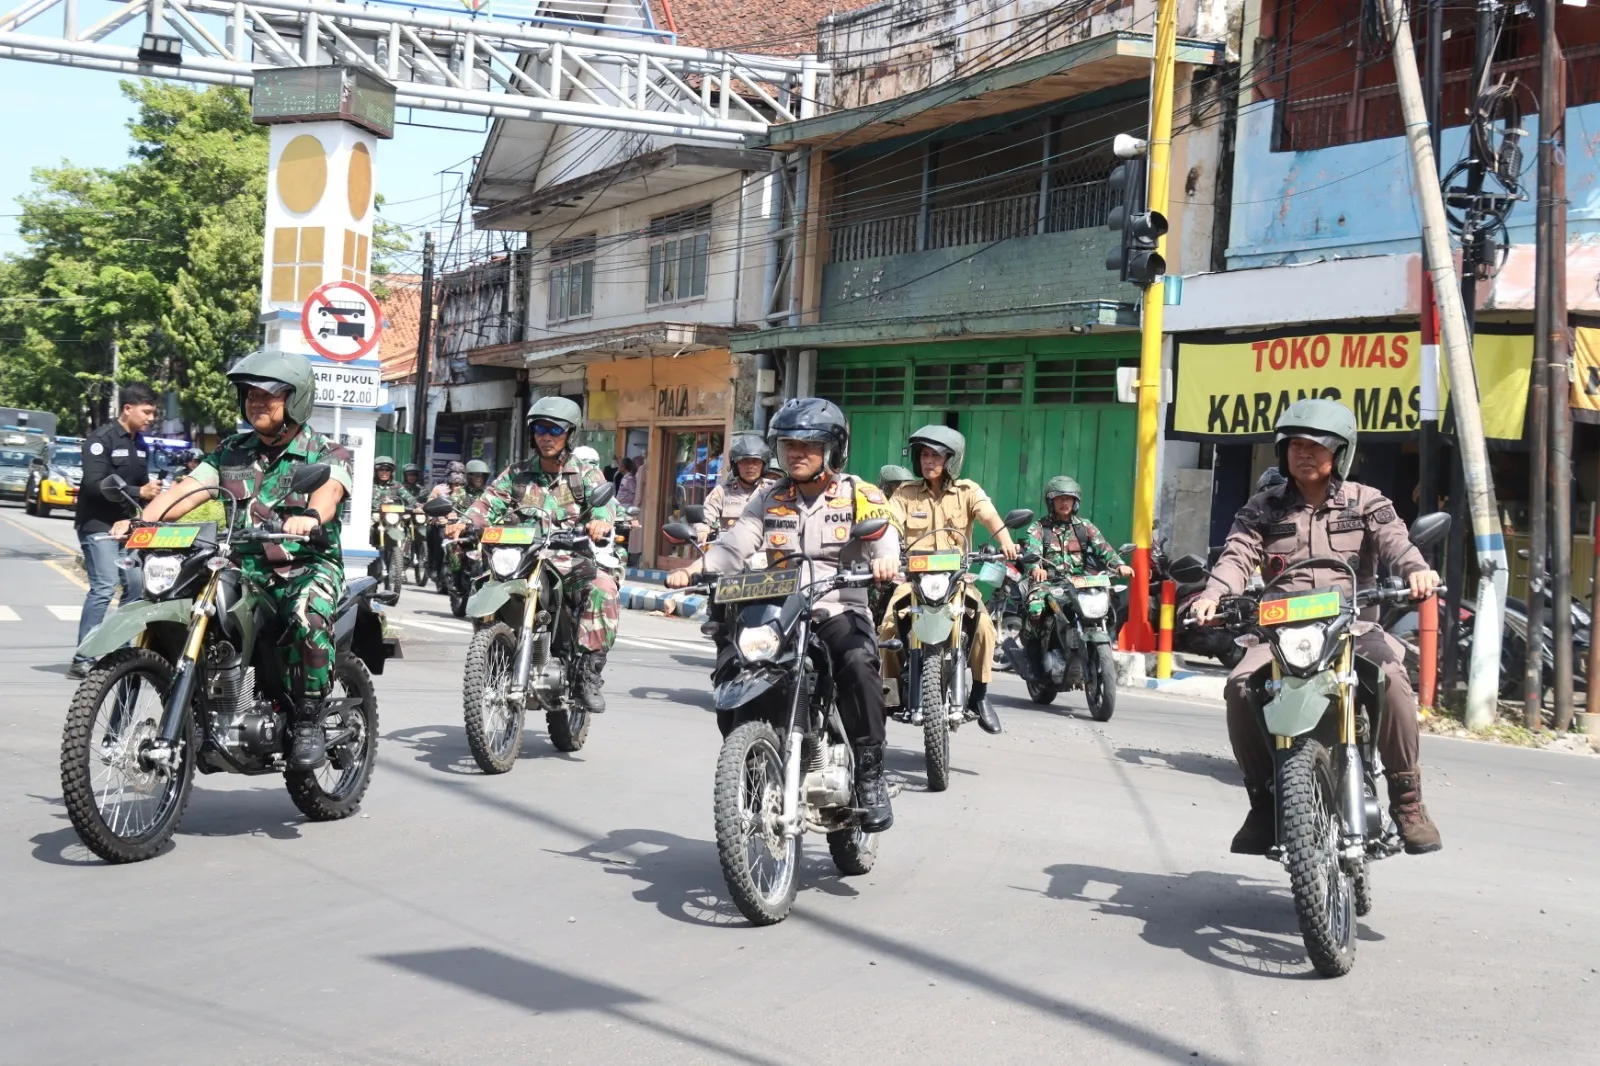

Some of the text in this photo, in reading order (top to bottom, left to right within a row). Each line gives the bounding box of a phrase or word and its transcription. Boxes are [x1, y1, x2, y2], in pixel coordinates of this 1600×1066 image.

[1252, 335, 1409, 372] TOKO MAS
[313, 373, 374, 385] ARI PUKUL
[313, 388, 335, 401] 6.00
[1207, 387, 1342, 433] KARA
[1353, 385, 1421, 430] MAS
[825, 513, 852, 523] POLR
